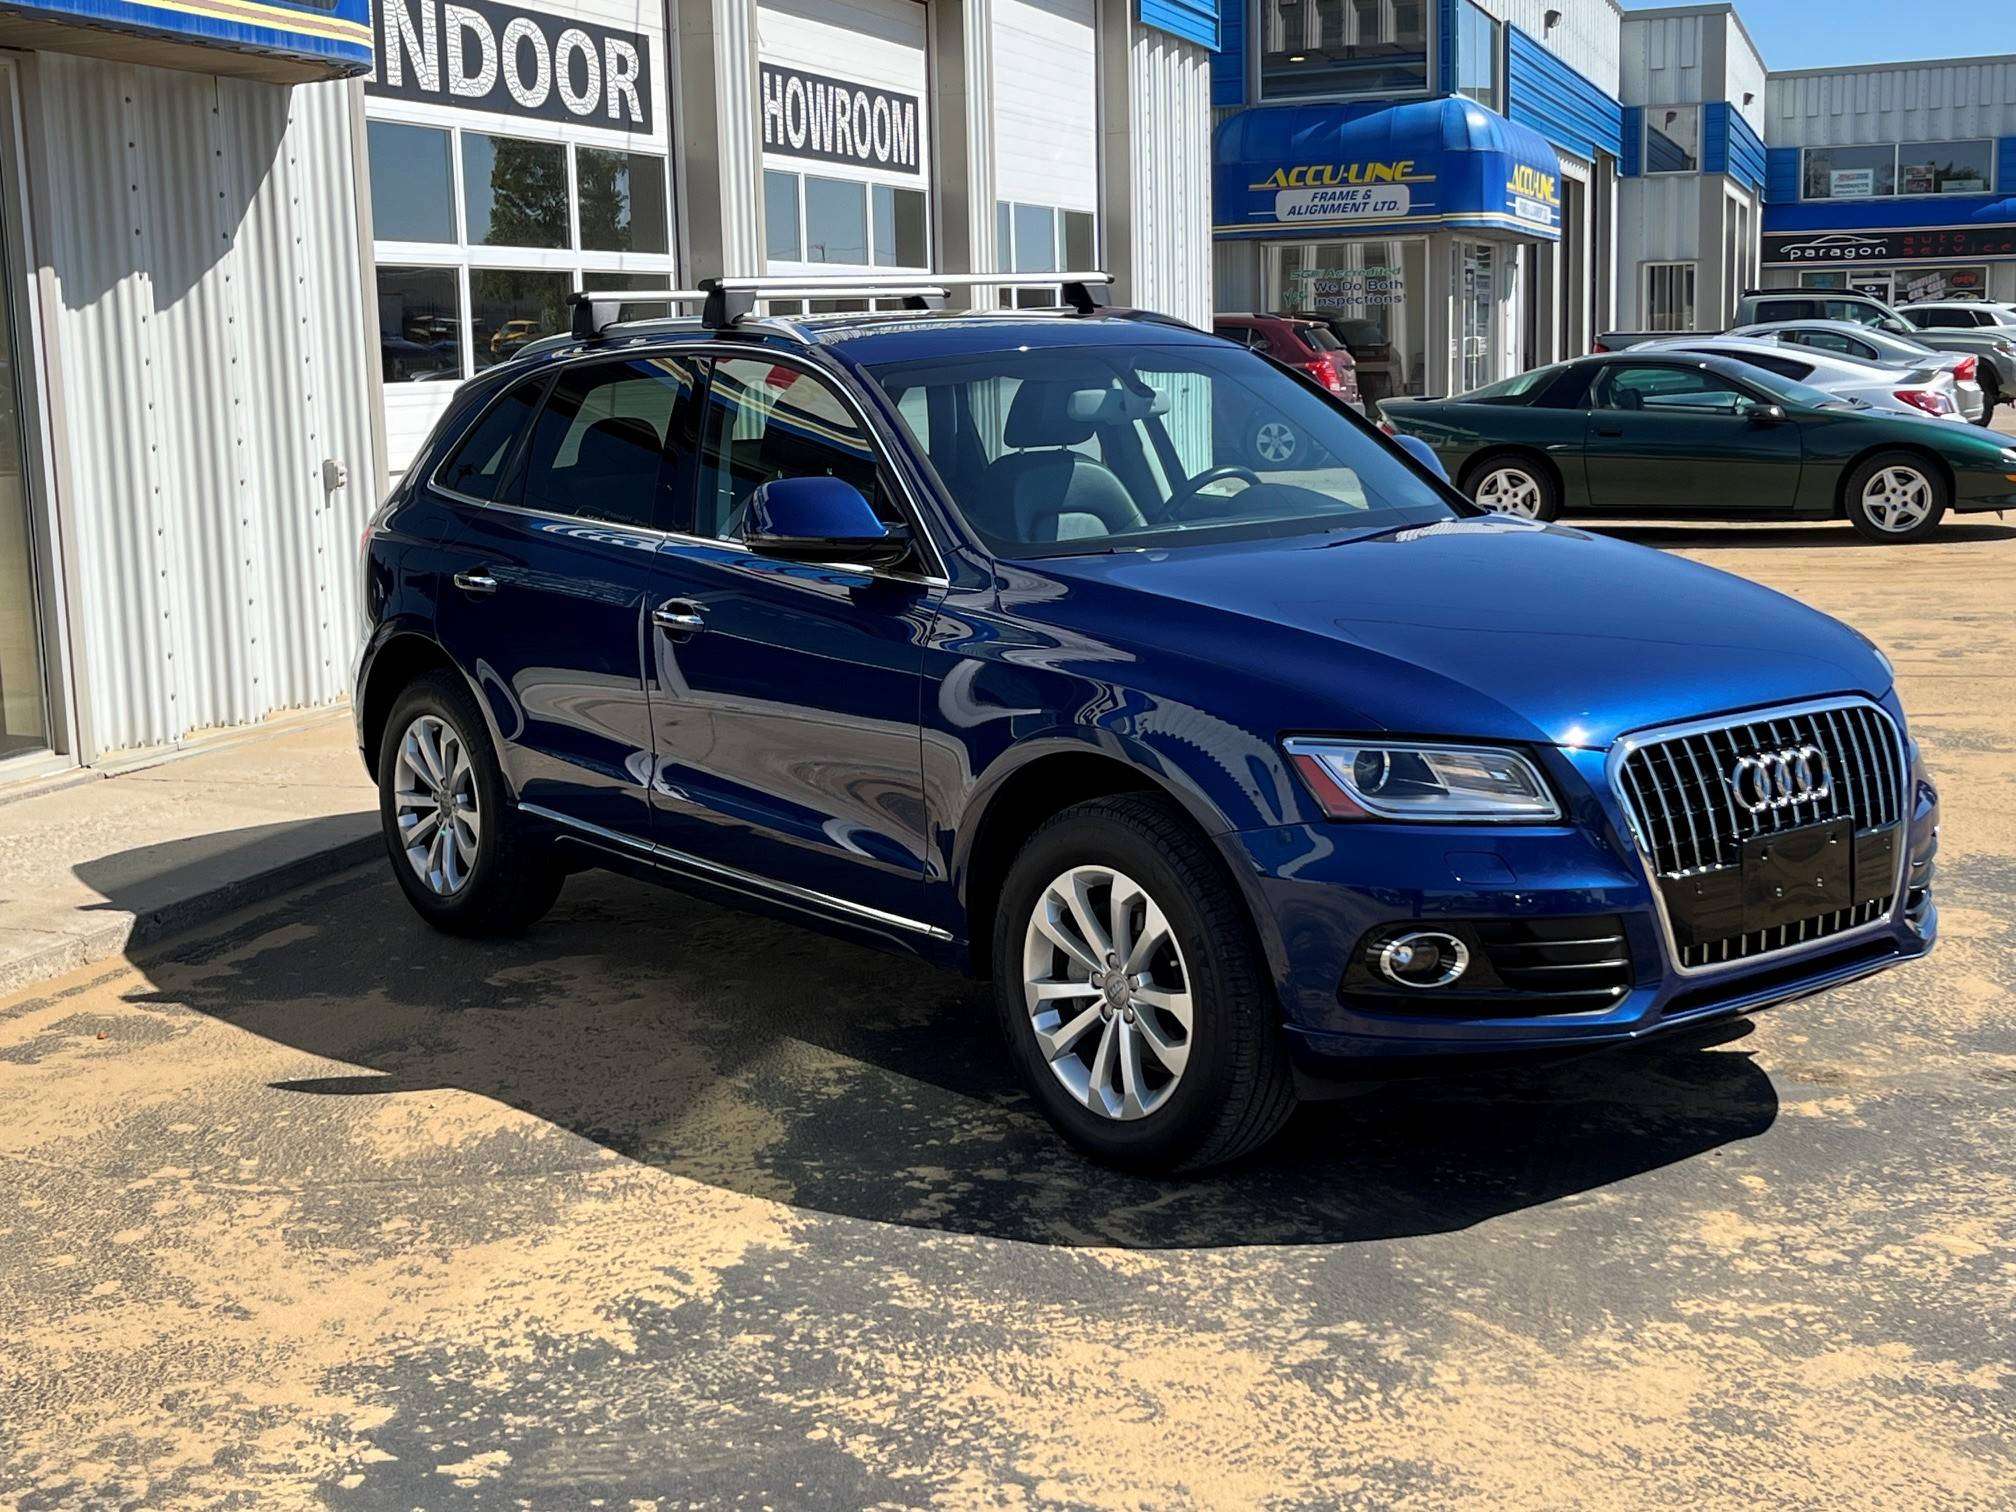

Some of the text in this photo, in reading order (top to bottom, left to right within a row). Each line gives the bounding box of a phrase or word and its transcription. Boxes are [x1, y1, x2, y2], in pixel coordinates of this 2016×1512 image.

[1264, 161, 1415, 186] ACCU-LINE
[1311, 189, 1372, 202] FRAME &
[1287, 200, 1400, 216] ALIGNMENT LTD.
[1790, 246, 1887, 261] paragon
[1313, 280, 1403, 294] We Do Both
